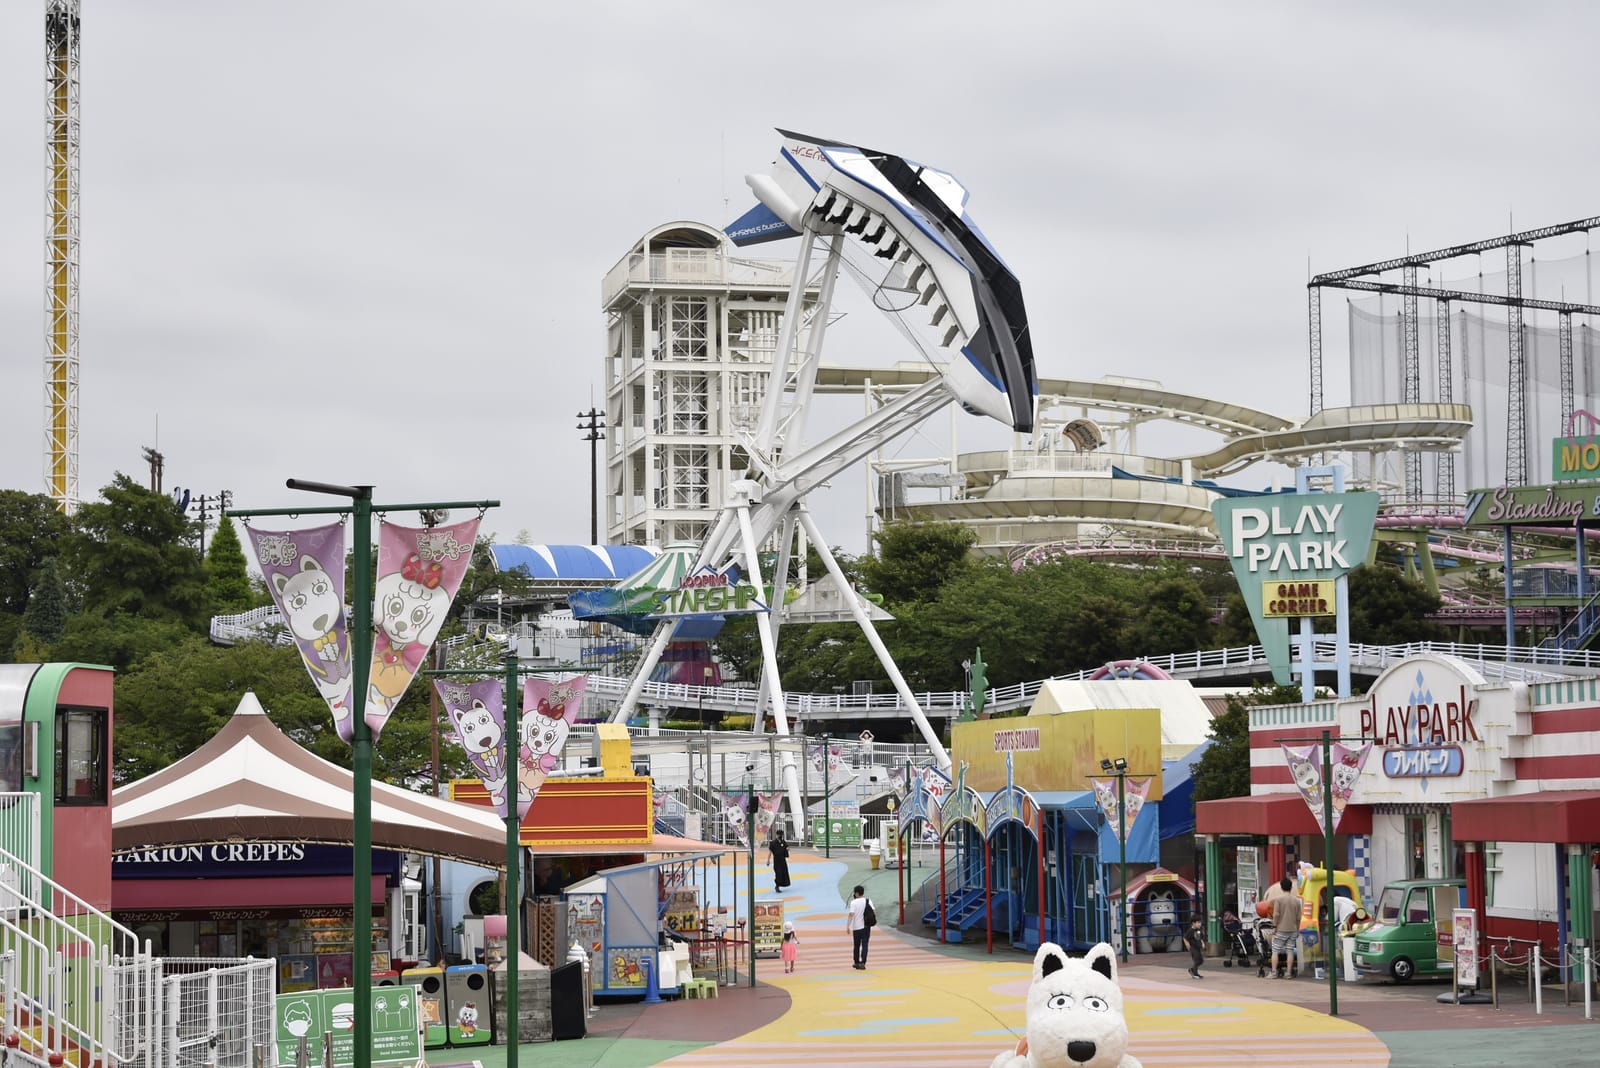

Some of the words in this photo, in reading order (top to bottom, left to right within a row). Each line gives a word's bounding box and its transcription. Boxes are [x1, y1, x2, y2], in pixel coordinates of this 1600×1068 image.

[1488, 485, 1584, 526] Standing
[1232, 504, 1343, 557] PLAY
[1249, 540, 1350, 571] PARK
[679, 574, 728, 589] LOOPING
[1278, 583, 1318, 598] GAME
[651, 584, 758, 614] STARSHIP
[1269, 599, 1328, 613] CORNER
[1360, 693, 1411, 746] PLAY
[1417, 685, 1479, 742] PARK
[994, 731, 1014, 751] SPORTS
[1015, 729, 1040, 750] STADIUM
[1391, 749, 1449, 774] プレイパーク
[211, 843, 305, 862] CREPES
[209, 910, 270, 920] マリオンクレープ
